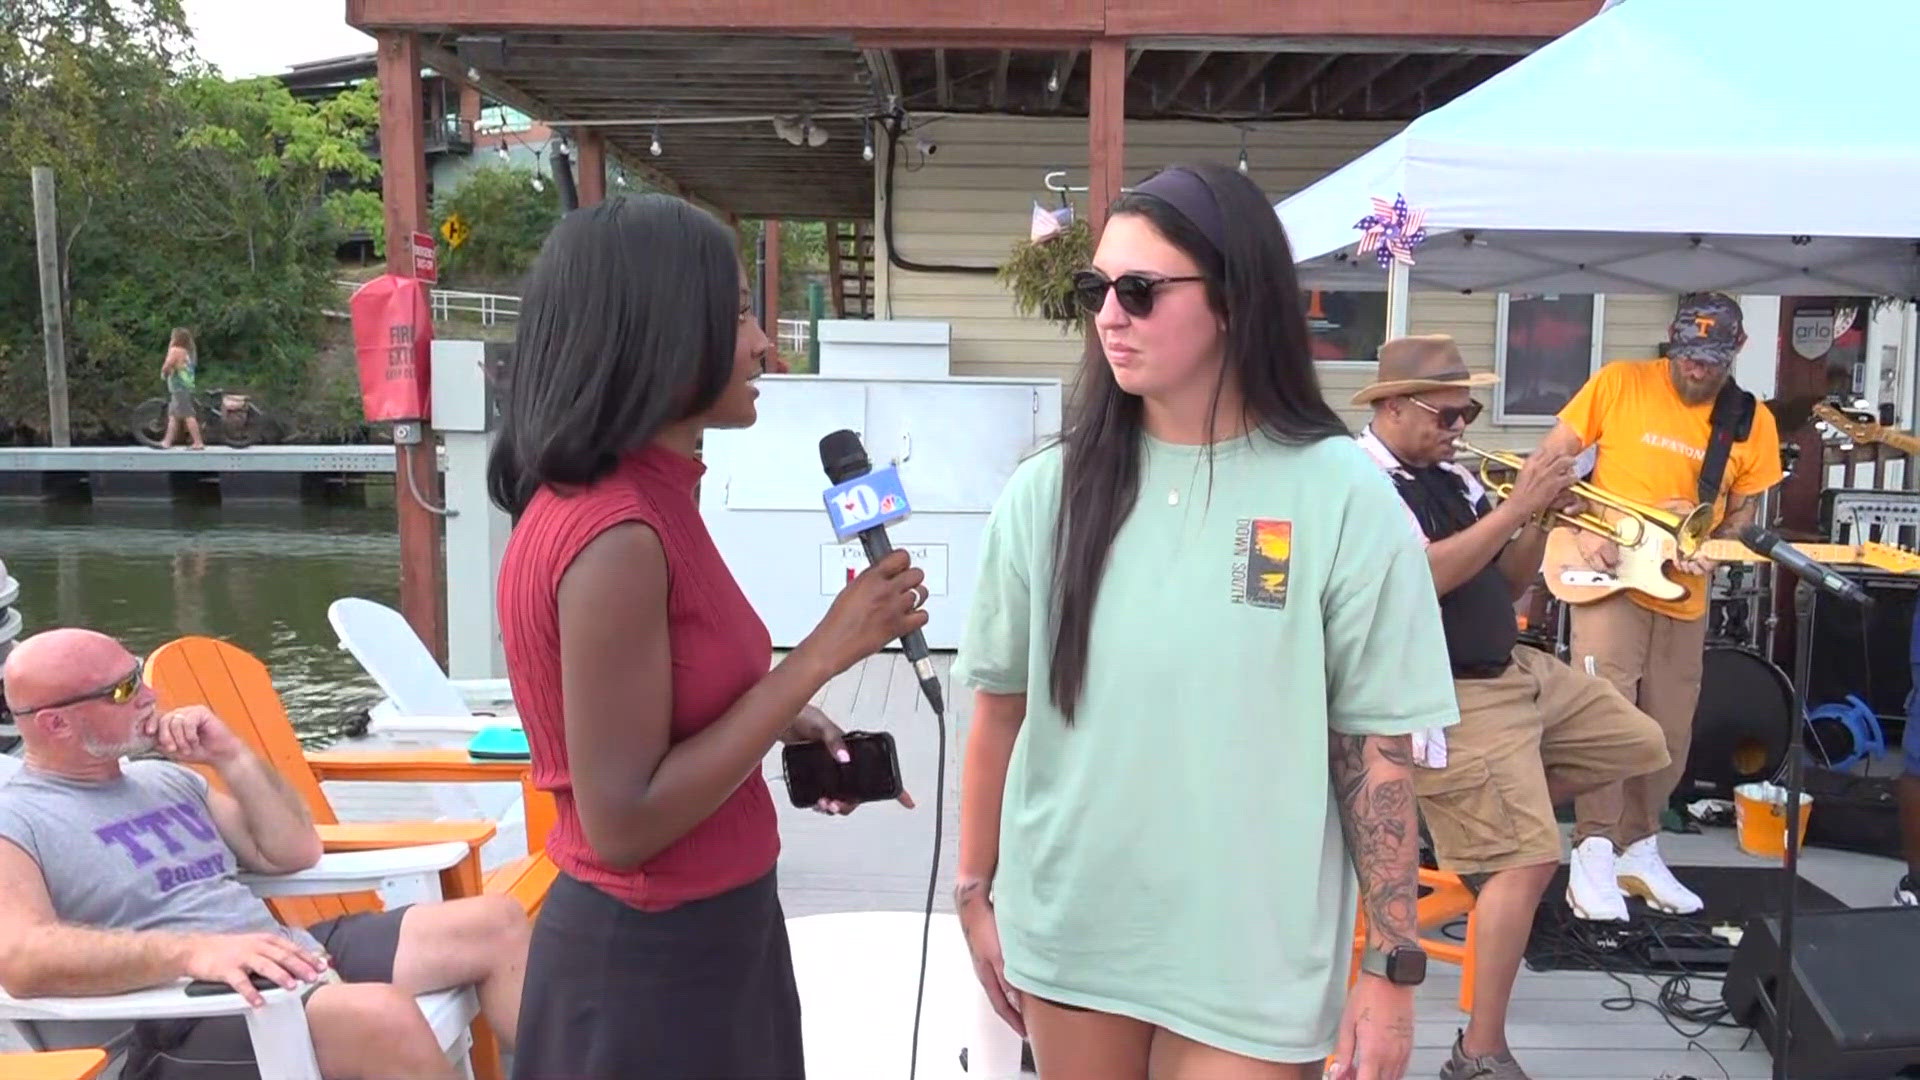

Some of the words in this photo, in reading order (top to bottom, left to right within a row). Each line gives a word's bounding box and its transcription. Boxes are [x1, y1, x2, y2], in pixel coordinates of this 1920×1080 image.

[1695, 317, 1715, 338] T
[1795, 321, 1831, 339] arlo
[831, 484, 880, 529] 10
[1233, 518, 1251, 556] DOWN
[1230, 562, 1247, 605] SOUTH
[95, 802, 217, 868] TTU
